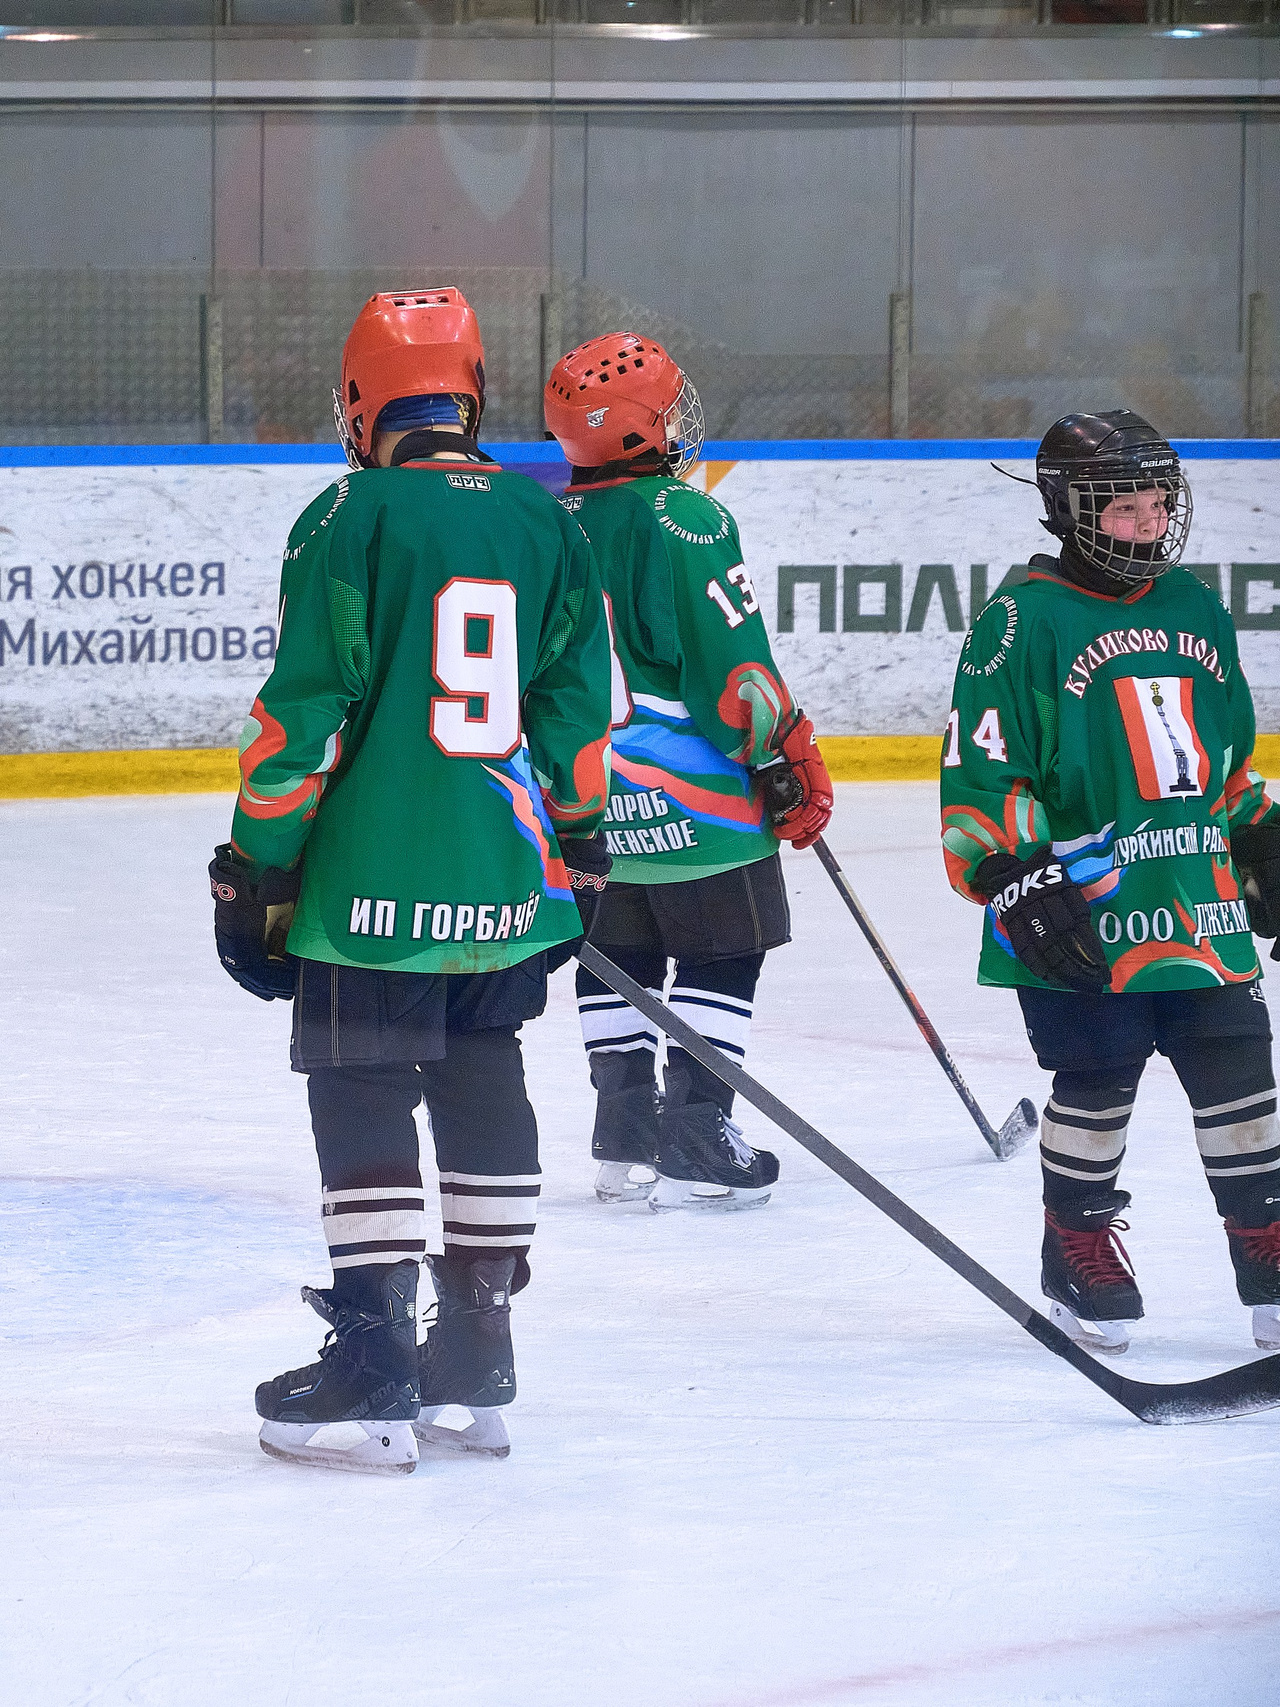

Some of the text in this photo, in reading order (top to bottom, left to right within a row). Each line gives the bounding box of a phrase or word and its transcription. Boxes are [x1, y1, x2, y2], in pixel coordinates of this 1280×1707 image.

[1141, 459, 1174, 468] BAUER
[51, 561, 226, 601] хоккея
[707, 563, 760, 629] 13
[431, 577, 521, 758] 9
[1063, 628, 1169, 700] КУЛИКОВО
[942, 708, 1009, 768] 14
[349, 890, 540, 941] ИП ГОРБАЧЁ
[1031, 918, 1047, 938] 100
[1099, 900, 1251, 946] ООО ДЖЕМ
